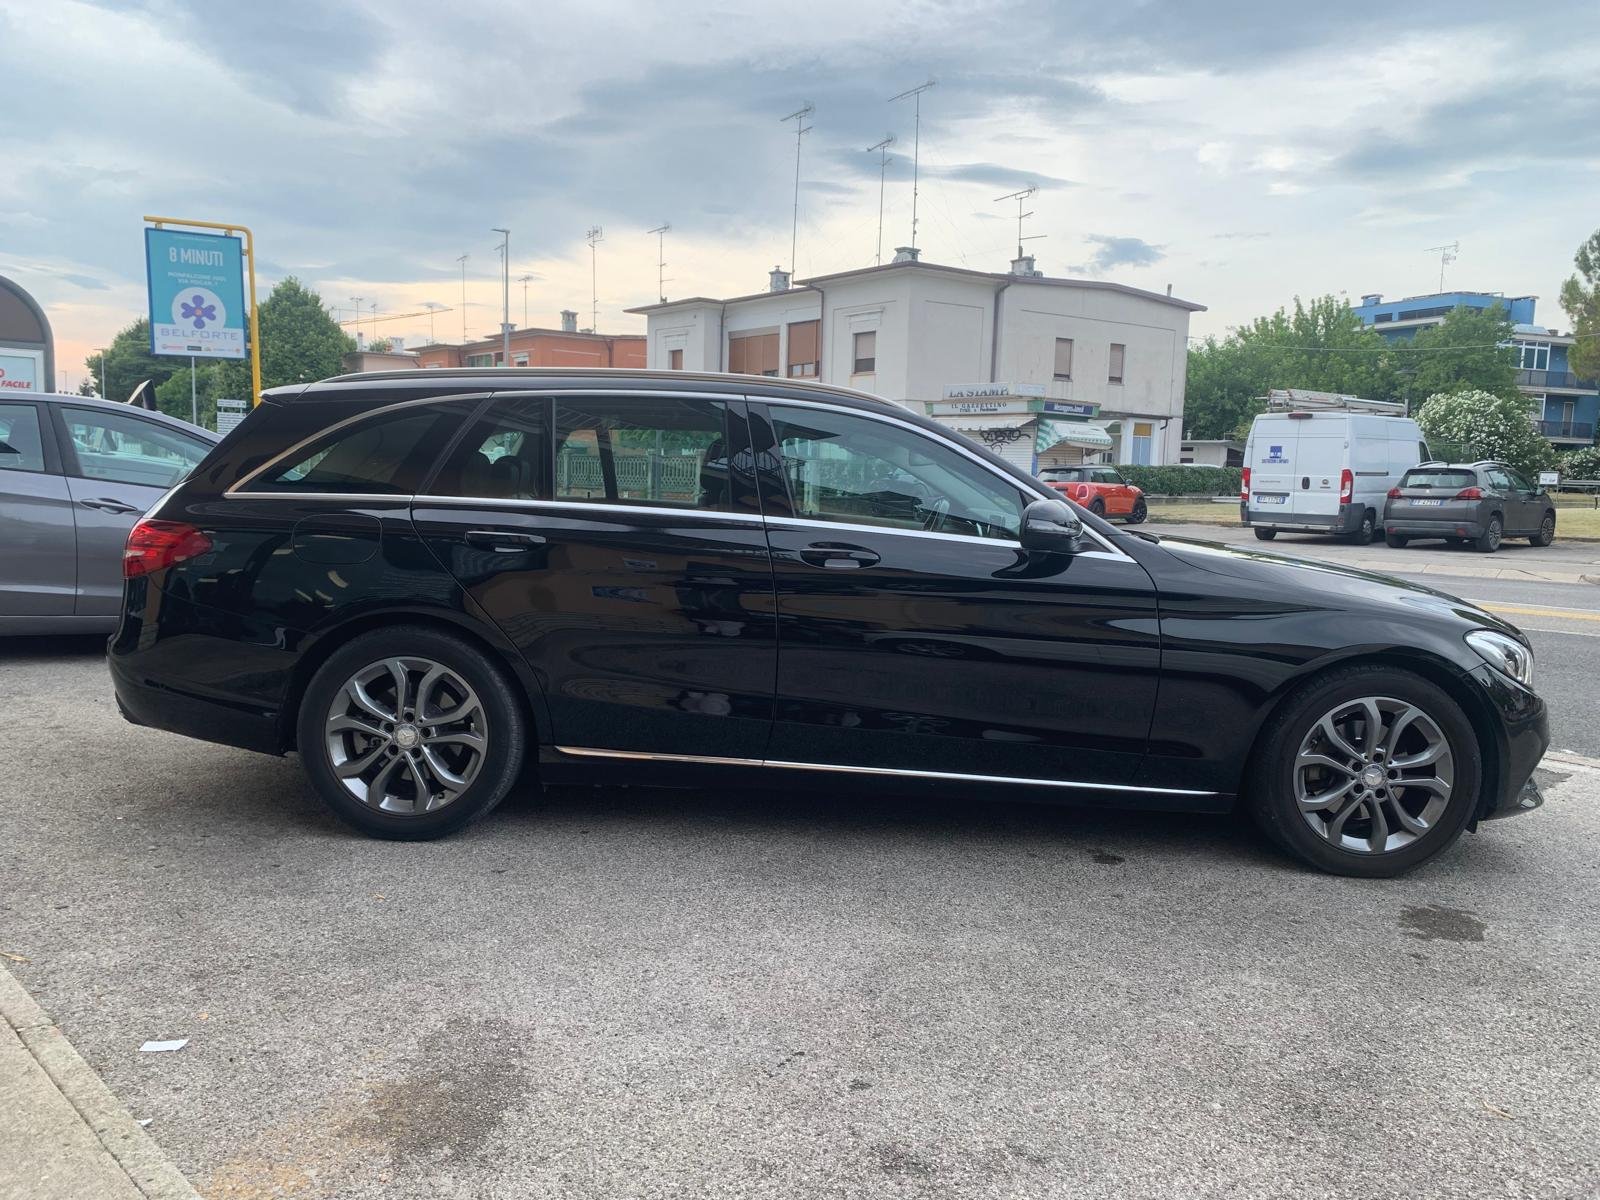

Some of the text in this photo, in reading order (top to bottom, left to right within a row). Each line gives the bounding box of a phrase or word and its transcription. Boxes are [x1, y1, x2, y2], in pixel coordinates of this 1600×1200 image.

[169, 246, 224, 267] 8 MINUTI
[160, 327, 239, 341] BELFORTE
[1, 380, 32, 389] FACILE
